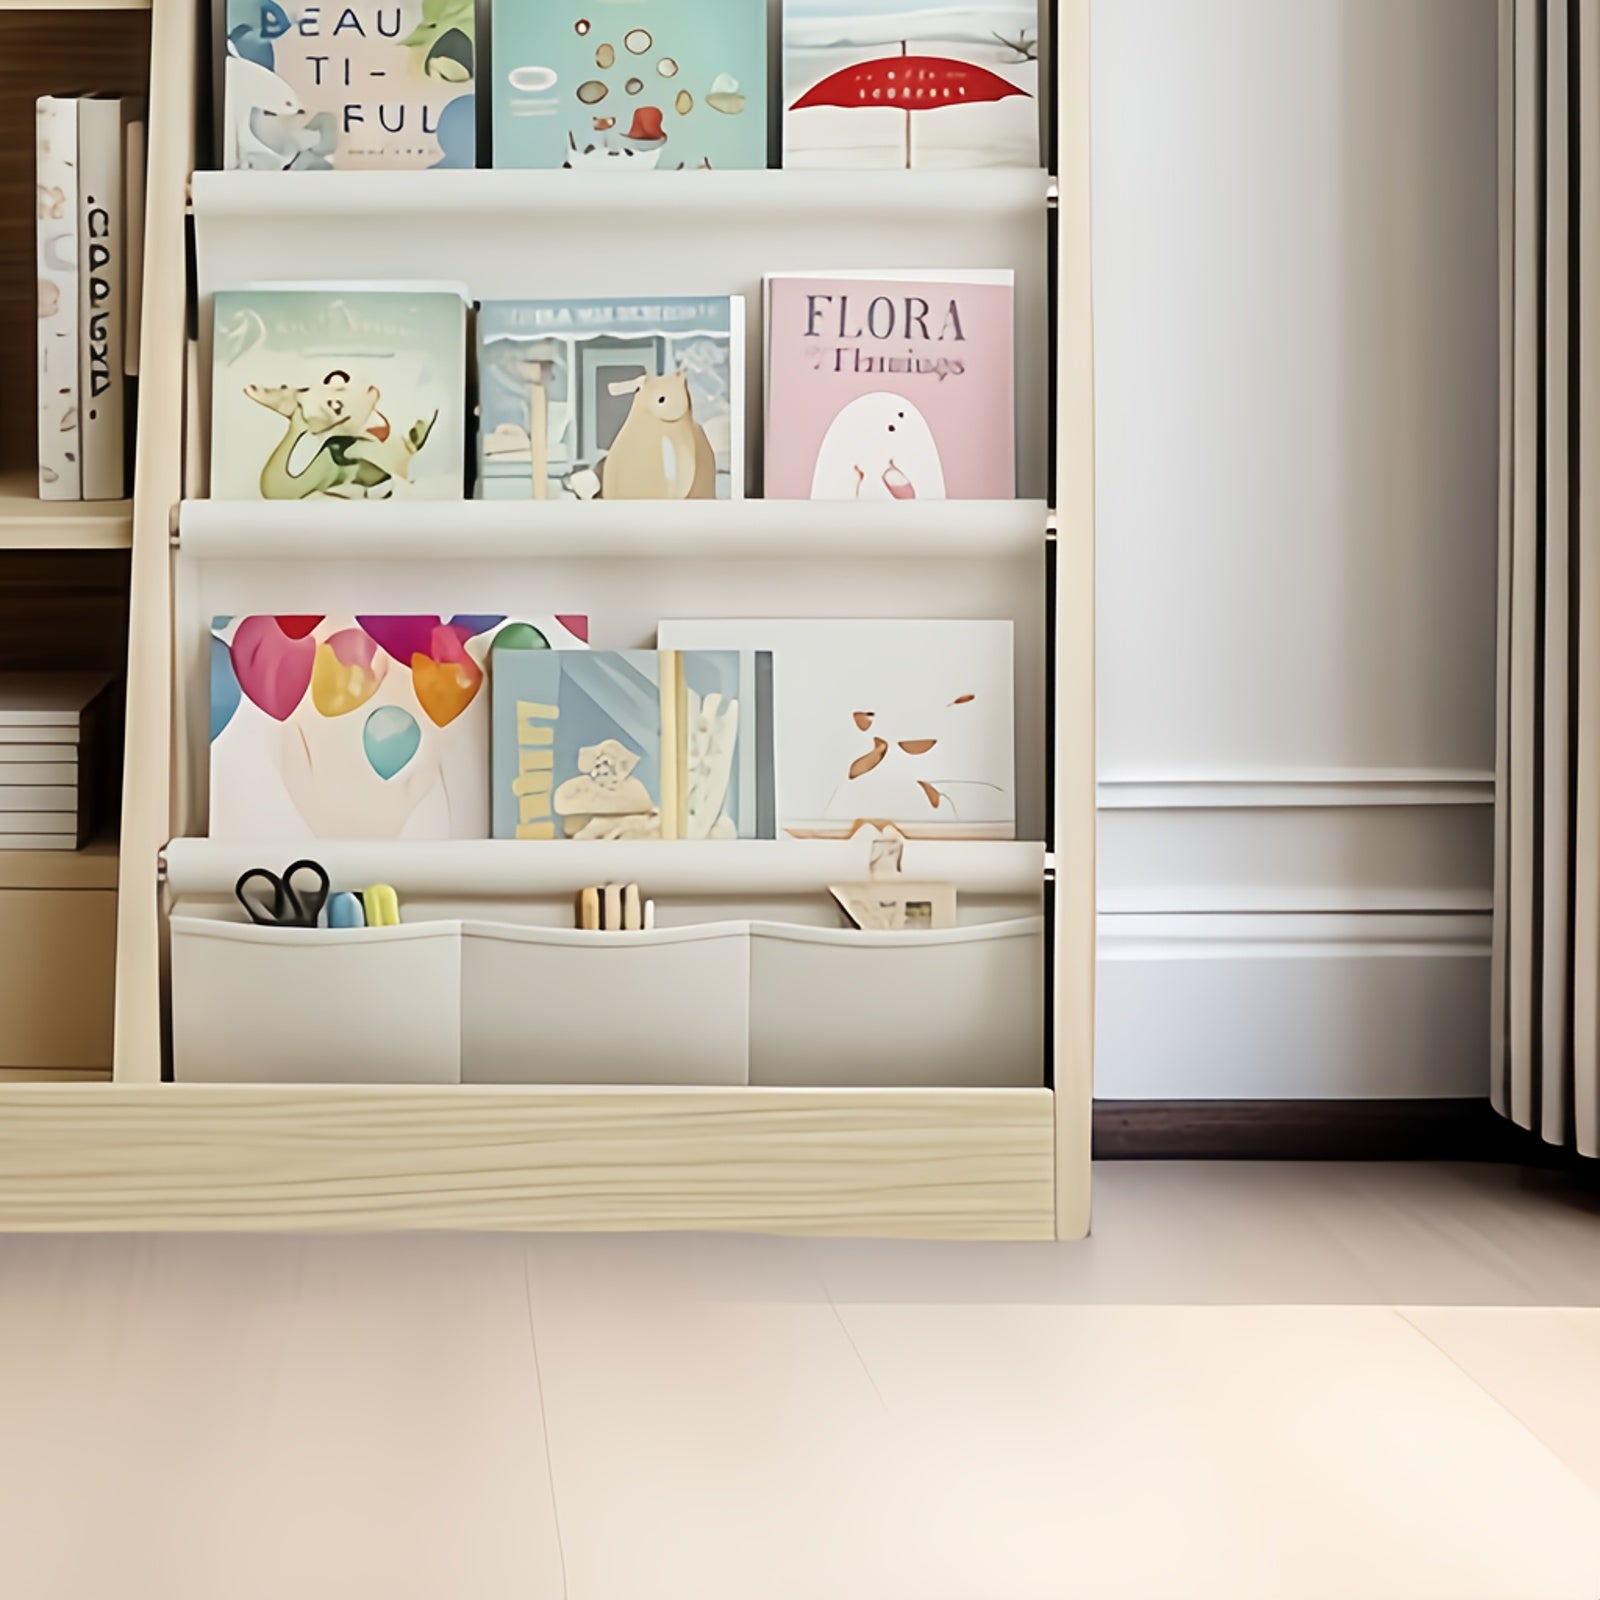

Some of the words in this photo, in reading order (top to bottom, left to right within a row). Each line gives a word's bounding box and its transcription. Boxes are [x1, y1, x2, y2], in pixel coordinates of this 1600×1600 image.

[260, 6, 402, 39] BEAU
[343, 104, 438, 134] FUL
[803, 294, 967, 342] FLORA
